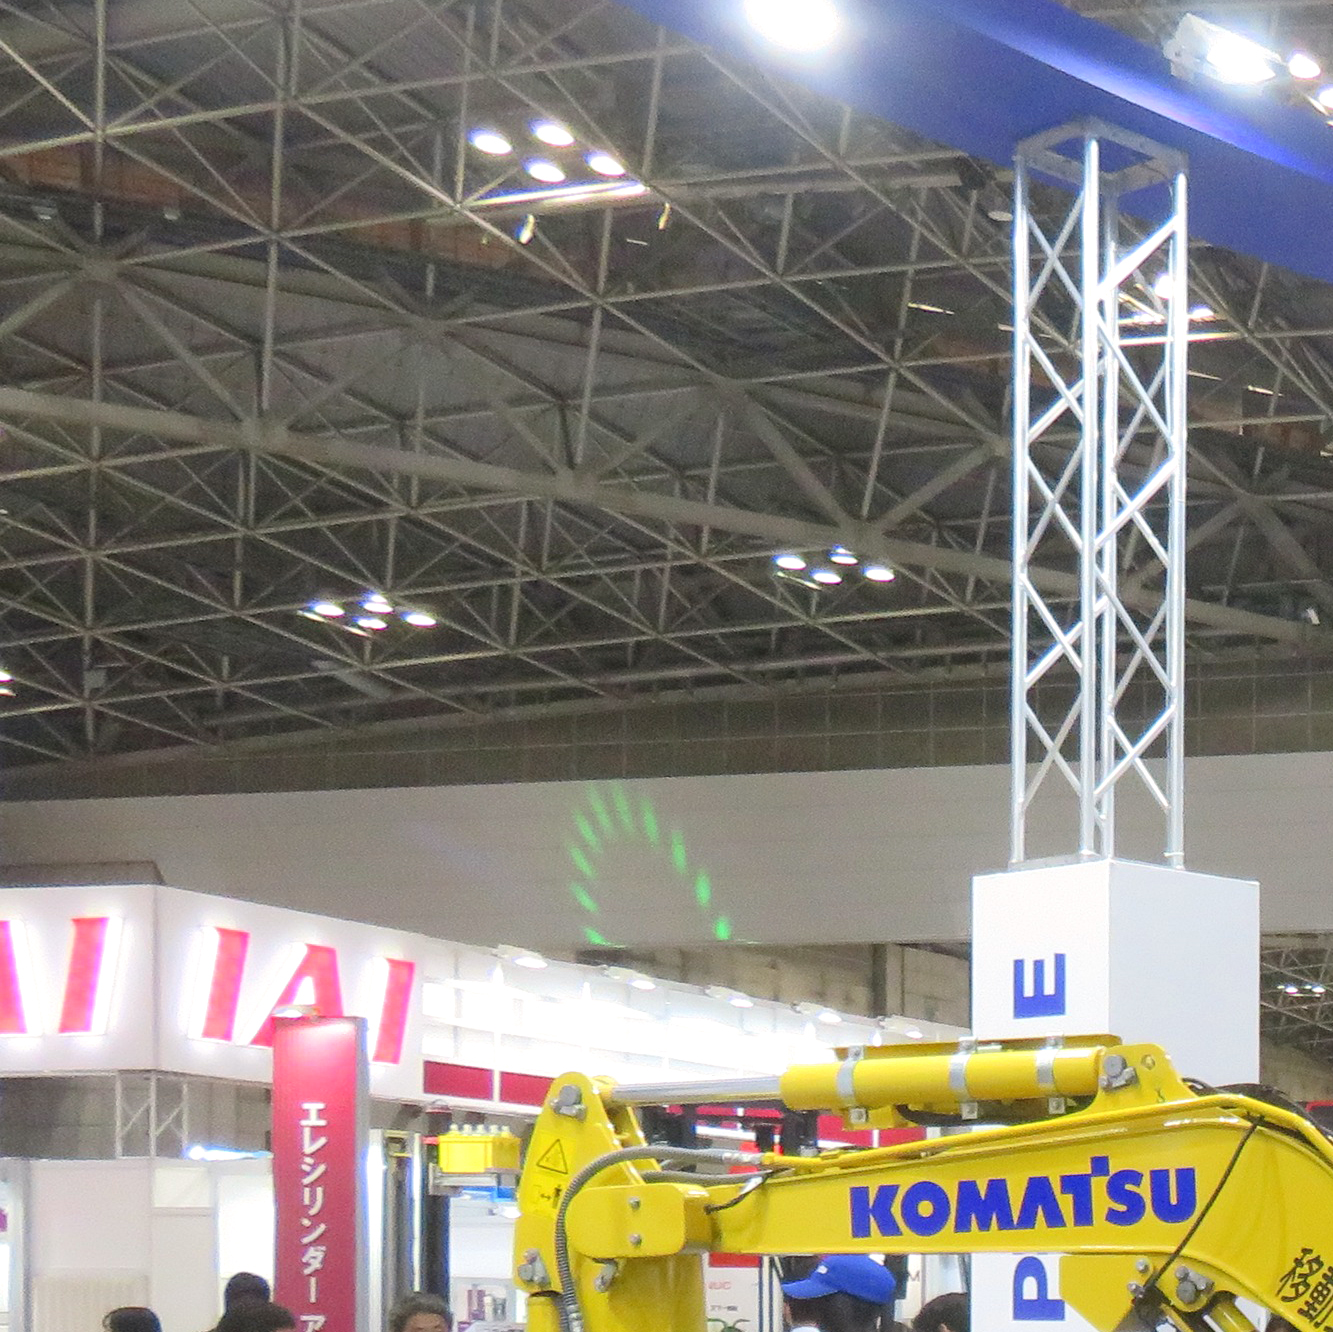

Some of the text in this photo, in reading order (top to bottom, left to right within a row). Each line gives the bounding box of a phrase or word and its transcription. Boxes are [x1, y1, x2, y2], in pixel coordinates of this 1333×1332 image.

[201, 927, 416, 1065] IAI
[300, 1102, 329, 1304] エレシリンダー
[851, 1156, 1197, 1239] KOMATSU
